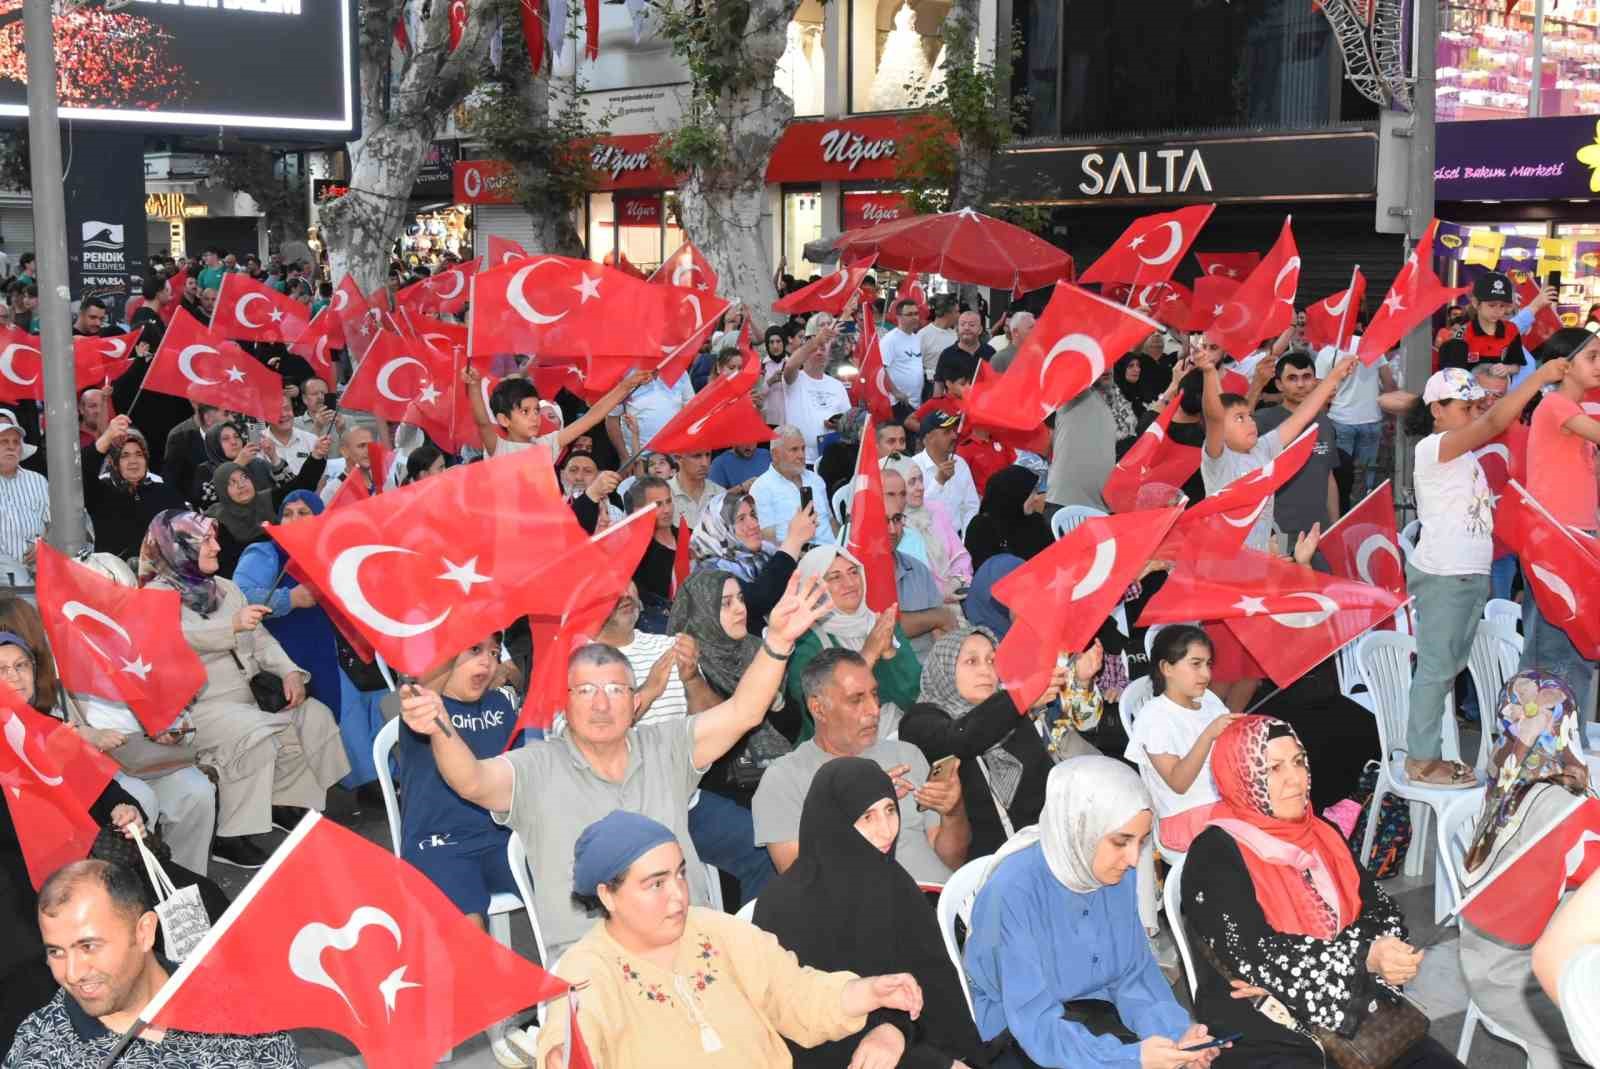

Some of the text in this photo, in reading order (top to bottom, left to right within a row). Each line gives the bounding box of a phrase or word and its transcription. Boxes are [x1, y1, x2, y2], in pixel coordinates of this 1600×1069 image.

[820, 129, 895, 172] Uğur
[1079, 149, 1213, 195] SALTA
[1509, 162, 1565, 177] Marketi
[862, 202, 899, 225] Uğur
